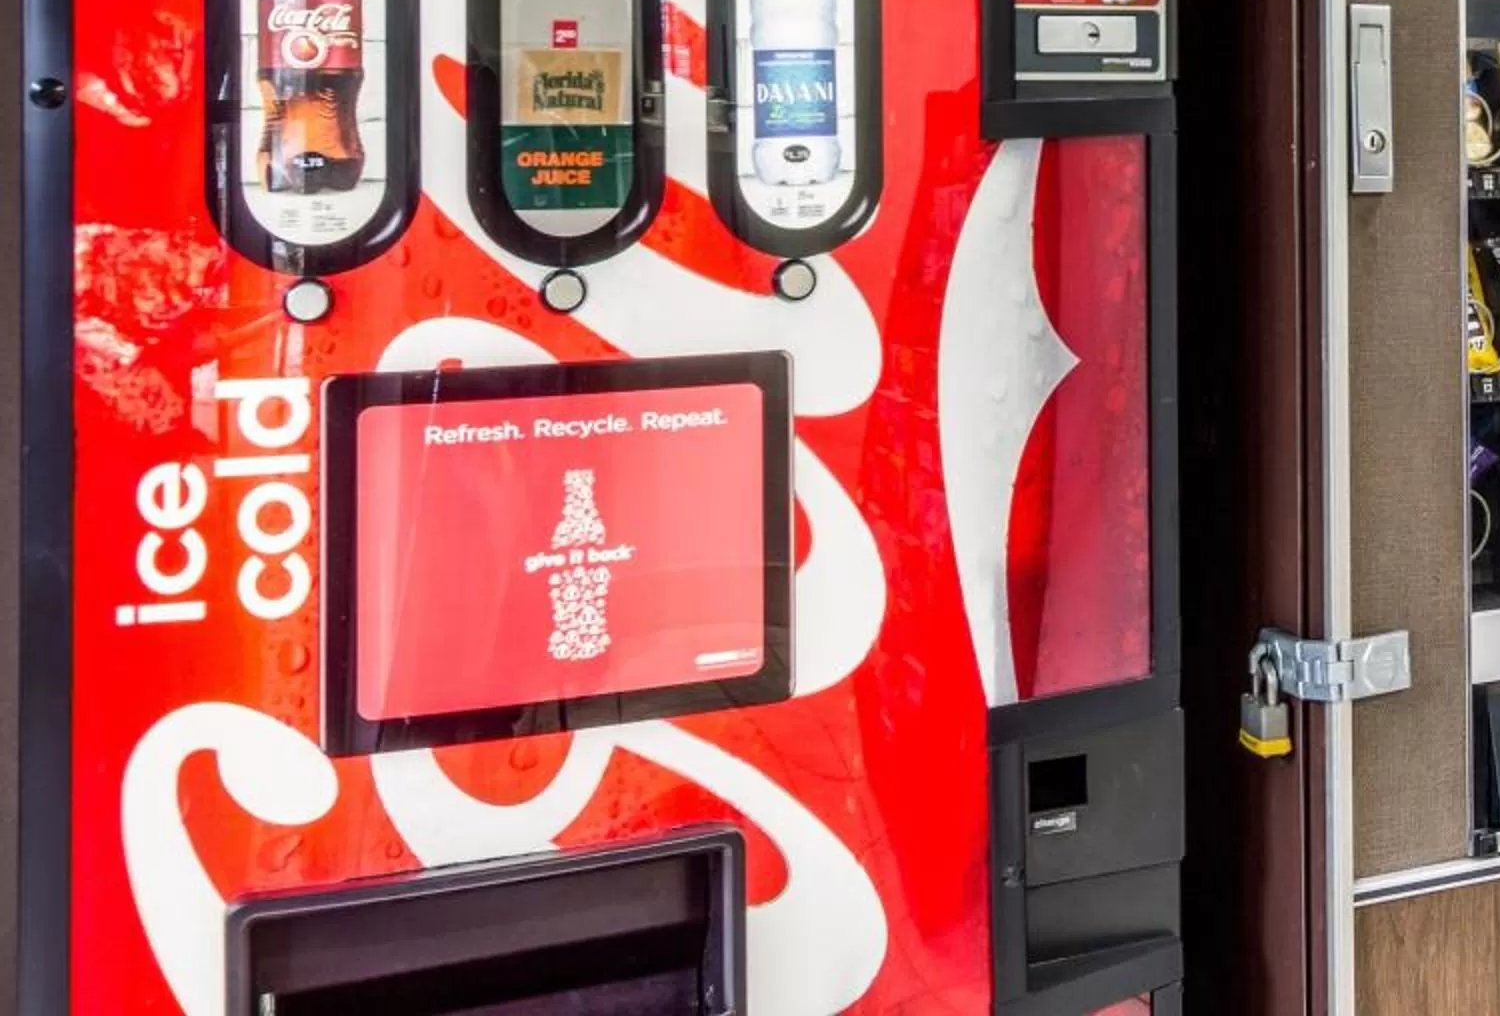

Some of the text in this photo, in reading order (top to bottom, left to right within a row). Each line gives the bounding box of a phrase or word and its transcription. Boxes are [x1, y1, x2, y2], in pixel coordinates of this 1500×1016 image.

[267, 3, 353, 33] Coca-Cola
[756, 82, 835, 104] DASANI
[516, 151, 605, 168] ORANGE
[531, 169, 593, 186] JUICE
[424, 408, 728, 445] Refresh. Recycle. Repeat.
[213, 377, 312, 621] cold
[116, 460, 207, 626] ice
[524, 545, 631, 572] give it back
